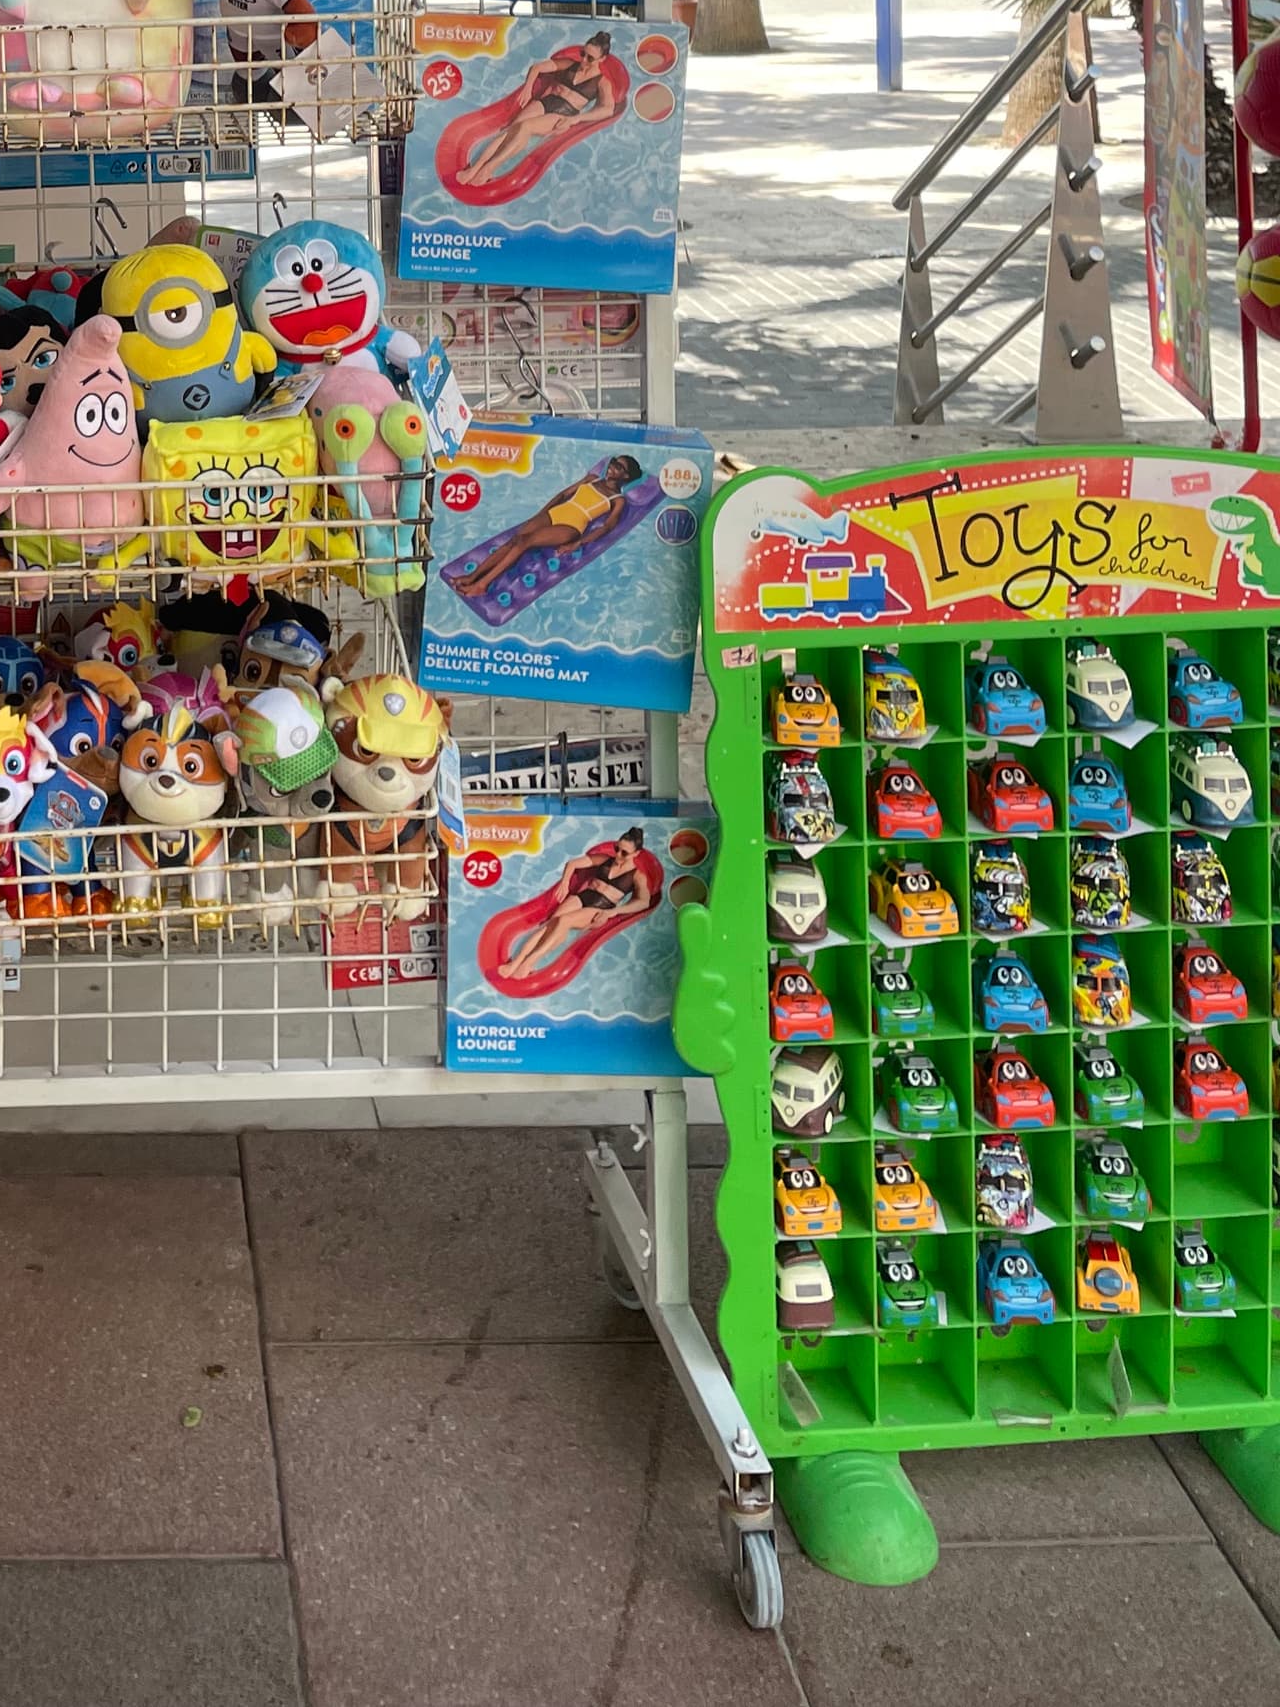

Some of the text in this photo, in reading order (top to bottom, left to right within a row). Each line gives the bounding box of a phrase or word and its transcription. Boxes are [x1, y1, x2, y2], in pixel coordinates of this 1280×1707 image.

[423, 23, 496, 45] Bestway
[427, 63, 457, 97] 25€
[411, 245, 472, 261] LOUNGE
[460, 439, 521, 462] estway
[663, 467, 692, 481] 1.88
[445, 480, 478, 505] 25€
[889, 471, 1193, 611] Toys for
[426, 642, 490, 661] SUMMER
[424, 656, 483, 674] DELUXE
[484, 663, 555, 681] FLOATING
[557, 669, 590, 684] MAT
[587, 759, 644, 789] SET
[466, 858, 499, 881] 25€
[457, 1039, 517, 1052] LOUNGE
